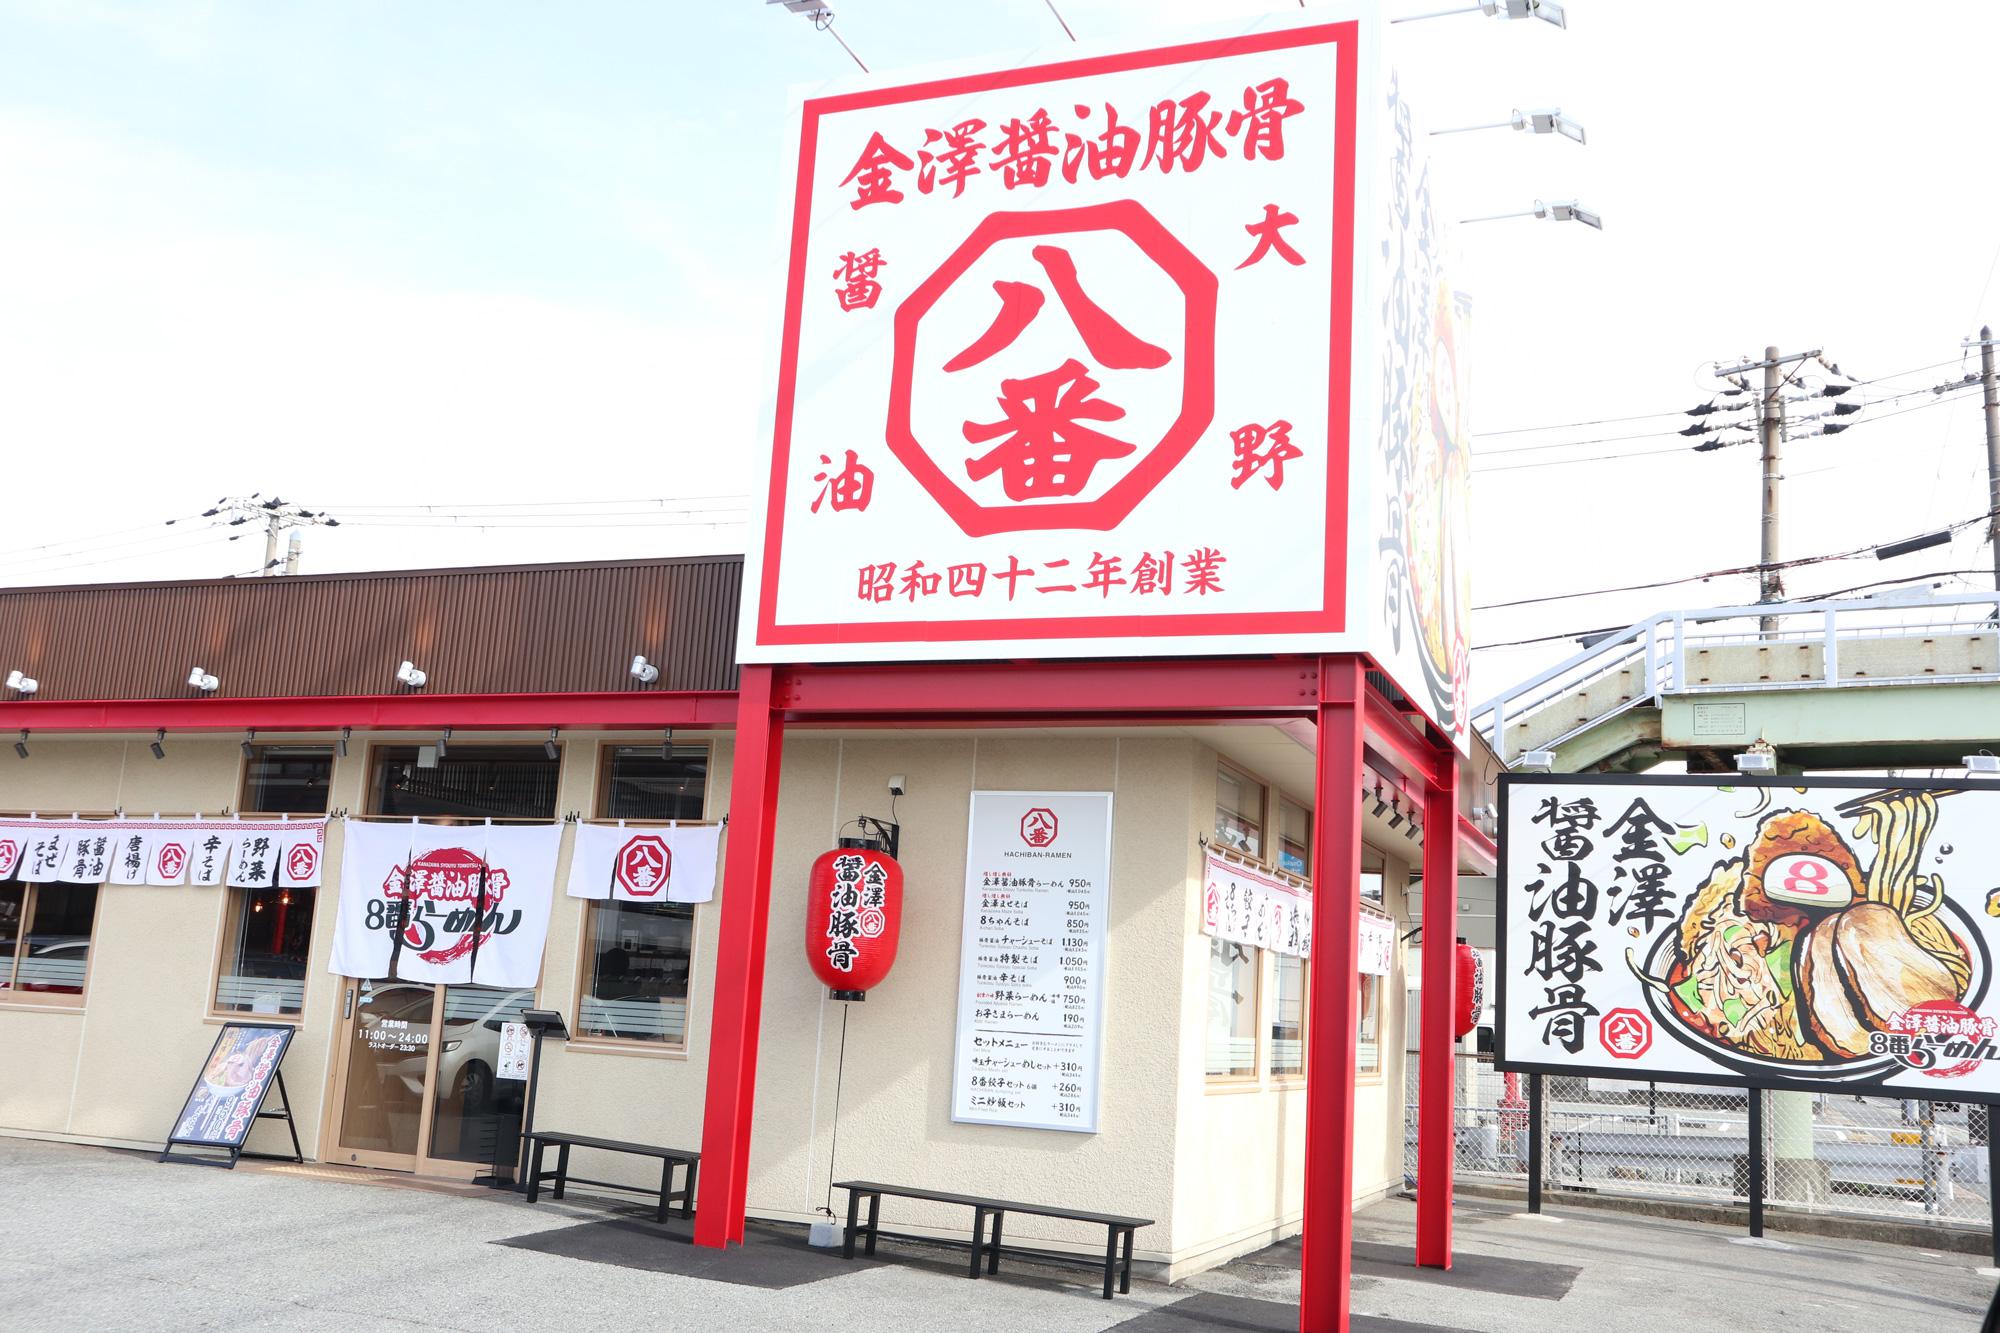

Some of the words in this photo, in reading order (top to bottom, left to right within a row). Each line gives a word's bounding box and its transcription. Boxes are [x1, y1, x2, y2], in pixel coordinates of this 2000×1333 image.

[839, 78, 1305, 211] 金澤醤油豚骨
[942, 245, 1172, 502] 八番
[857, 546, 1228, 604] 昭和四十二年創業
[1027, 813, 1053, 844] 八番
[72, 839, 91, 879] 豚骨
[87, 836, 107, 877] 醤油
[124, 835, 143, 880] 唐揚げ
[163, 849, 182, 874] 八番
[198, 835, 221, 882] 辛そば
[235, 837, 251, 883] らーめん
[248, 837, 270, 882] 野菜
[293, 851, 311, 876] 八番
[630, 846, 662, 887] 八番
[1004, 851, 1072, 859] HACHIBAN-RAMEN
[1603, 797, 1677, 934] 金澤
[386, 866, 508, 898] 金澤醤油豚骨
[864, 863, 887, 908] 金澤
[1069, 879, 1091, 888] 950円
[827, 855, 864, 970] 醤油豚骨
[980, 916, 1029, 926] 8ちゃんそば
[1066, 920, 1089, 928] 850円
[1068, 901, 1090, 910] 950円
[365, 899, 522, 951] 8番らーめん
[1524, 796, 1603, 1054] 醤油豚骨
[1063, 976, 1087, 985] 900円
[975, 1008, 1039, 1021] お子さまらーめん
[1063, 1014, 1085, 1023] 190円
[1063, 995, 1086, 1004] 750円
[381, 1019, 408, 1029] 営業時間
[1610, 1016, 1645, 1051] 八番
[1887, 1012, 1997, 1037] 金澤醤油豚骨
[368, 1042, 399, 1050] ラストオーダー
[400, 1044, 416, 1052] 23:30
[973, 1036, 1028, 1049] セットメニュー
[1870, 1032, 2000, 1070] 8番らーめん
